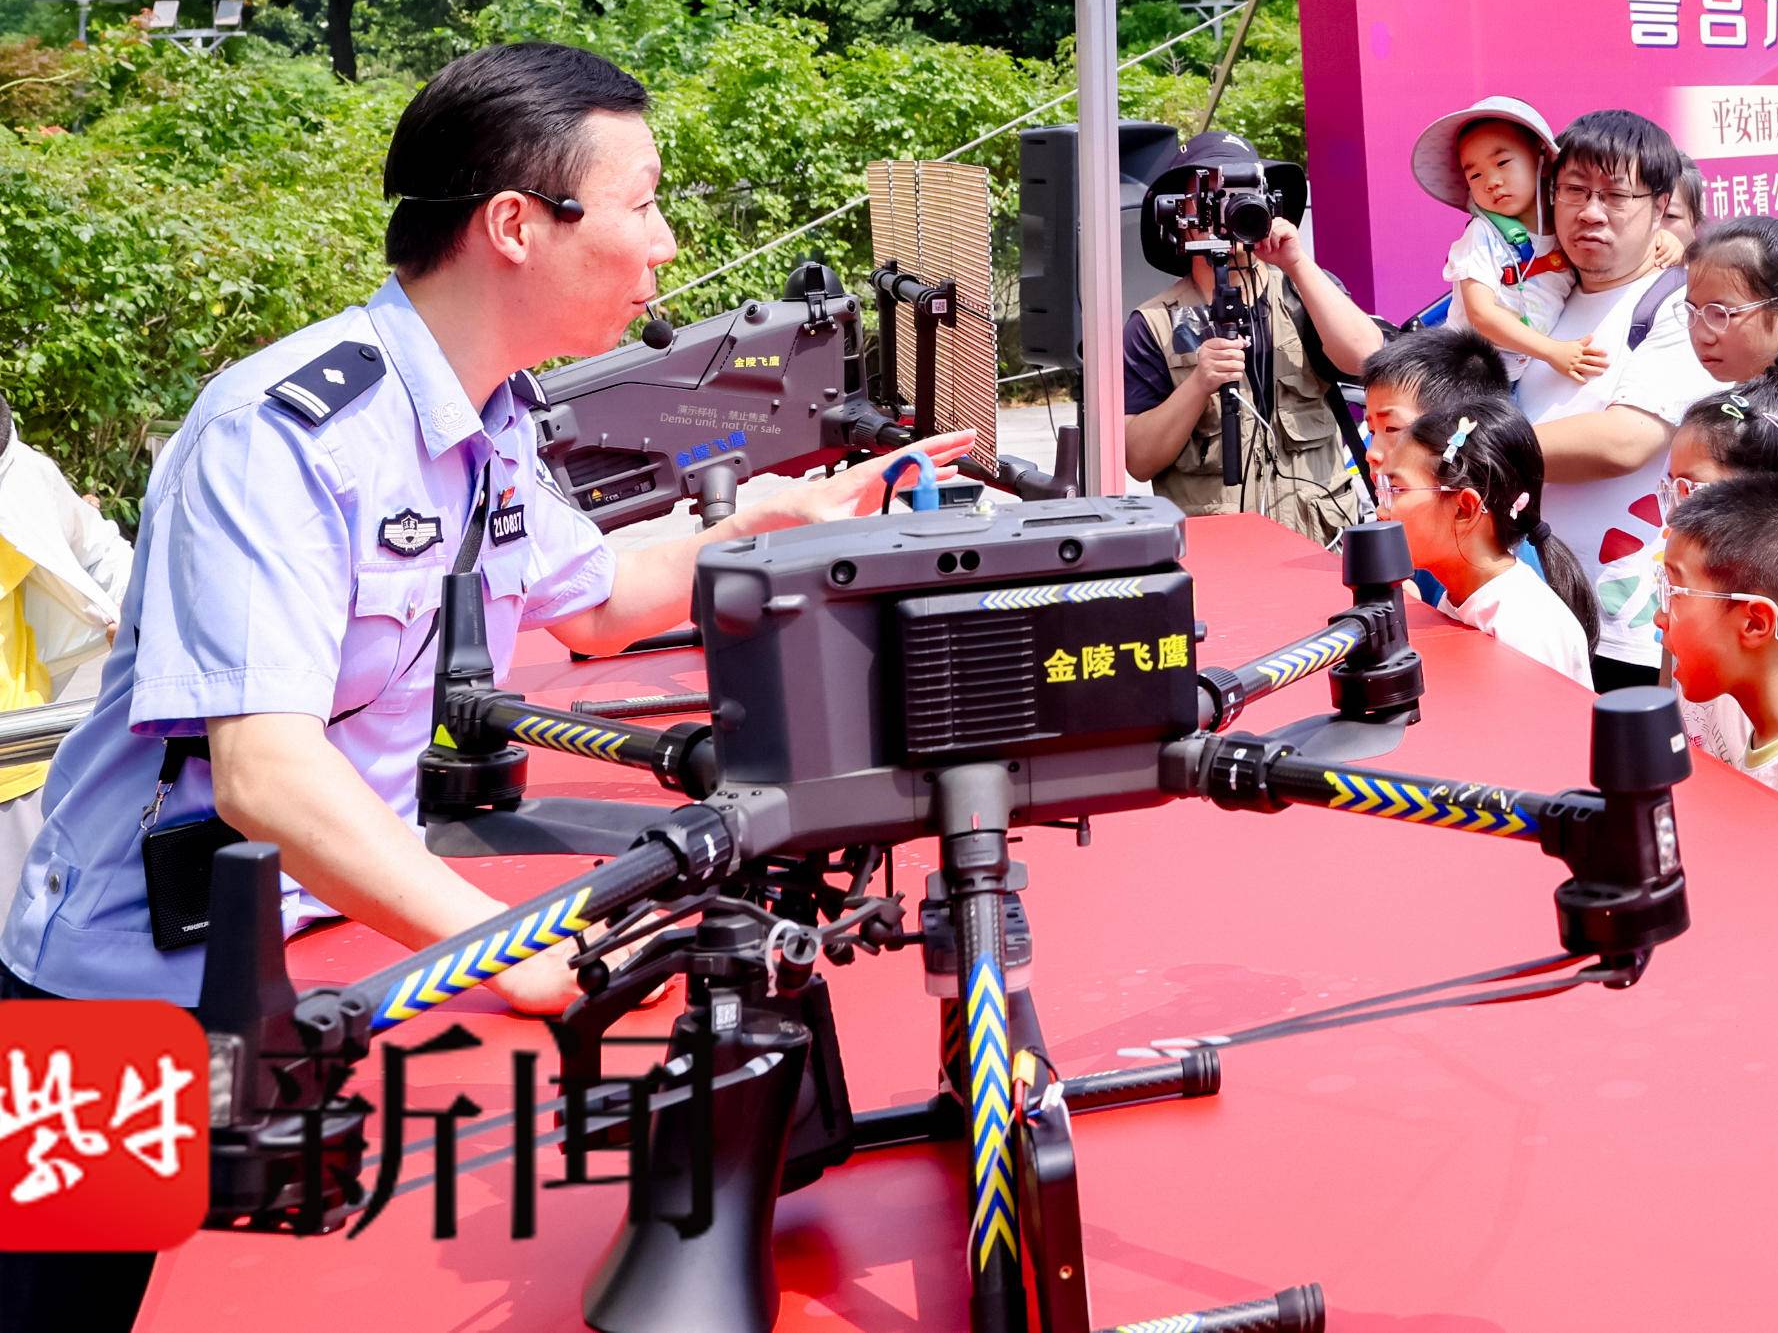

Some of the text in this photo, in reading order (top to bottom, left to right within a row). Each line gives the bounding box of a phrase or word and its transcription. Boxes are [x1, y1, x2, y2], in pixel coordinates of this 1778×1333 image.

[734, 356, 780, 368] 金陵飞鹰
[660, 412, 692, 426] Demo
[721, 420, 739, 431] not
[741, 422, 758, 433] for
[760, 424, 781, 435] sale
[493, 511, 522, 538] 210837
[1043, 634, 1188, 683] 金陵飞鹰
